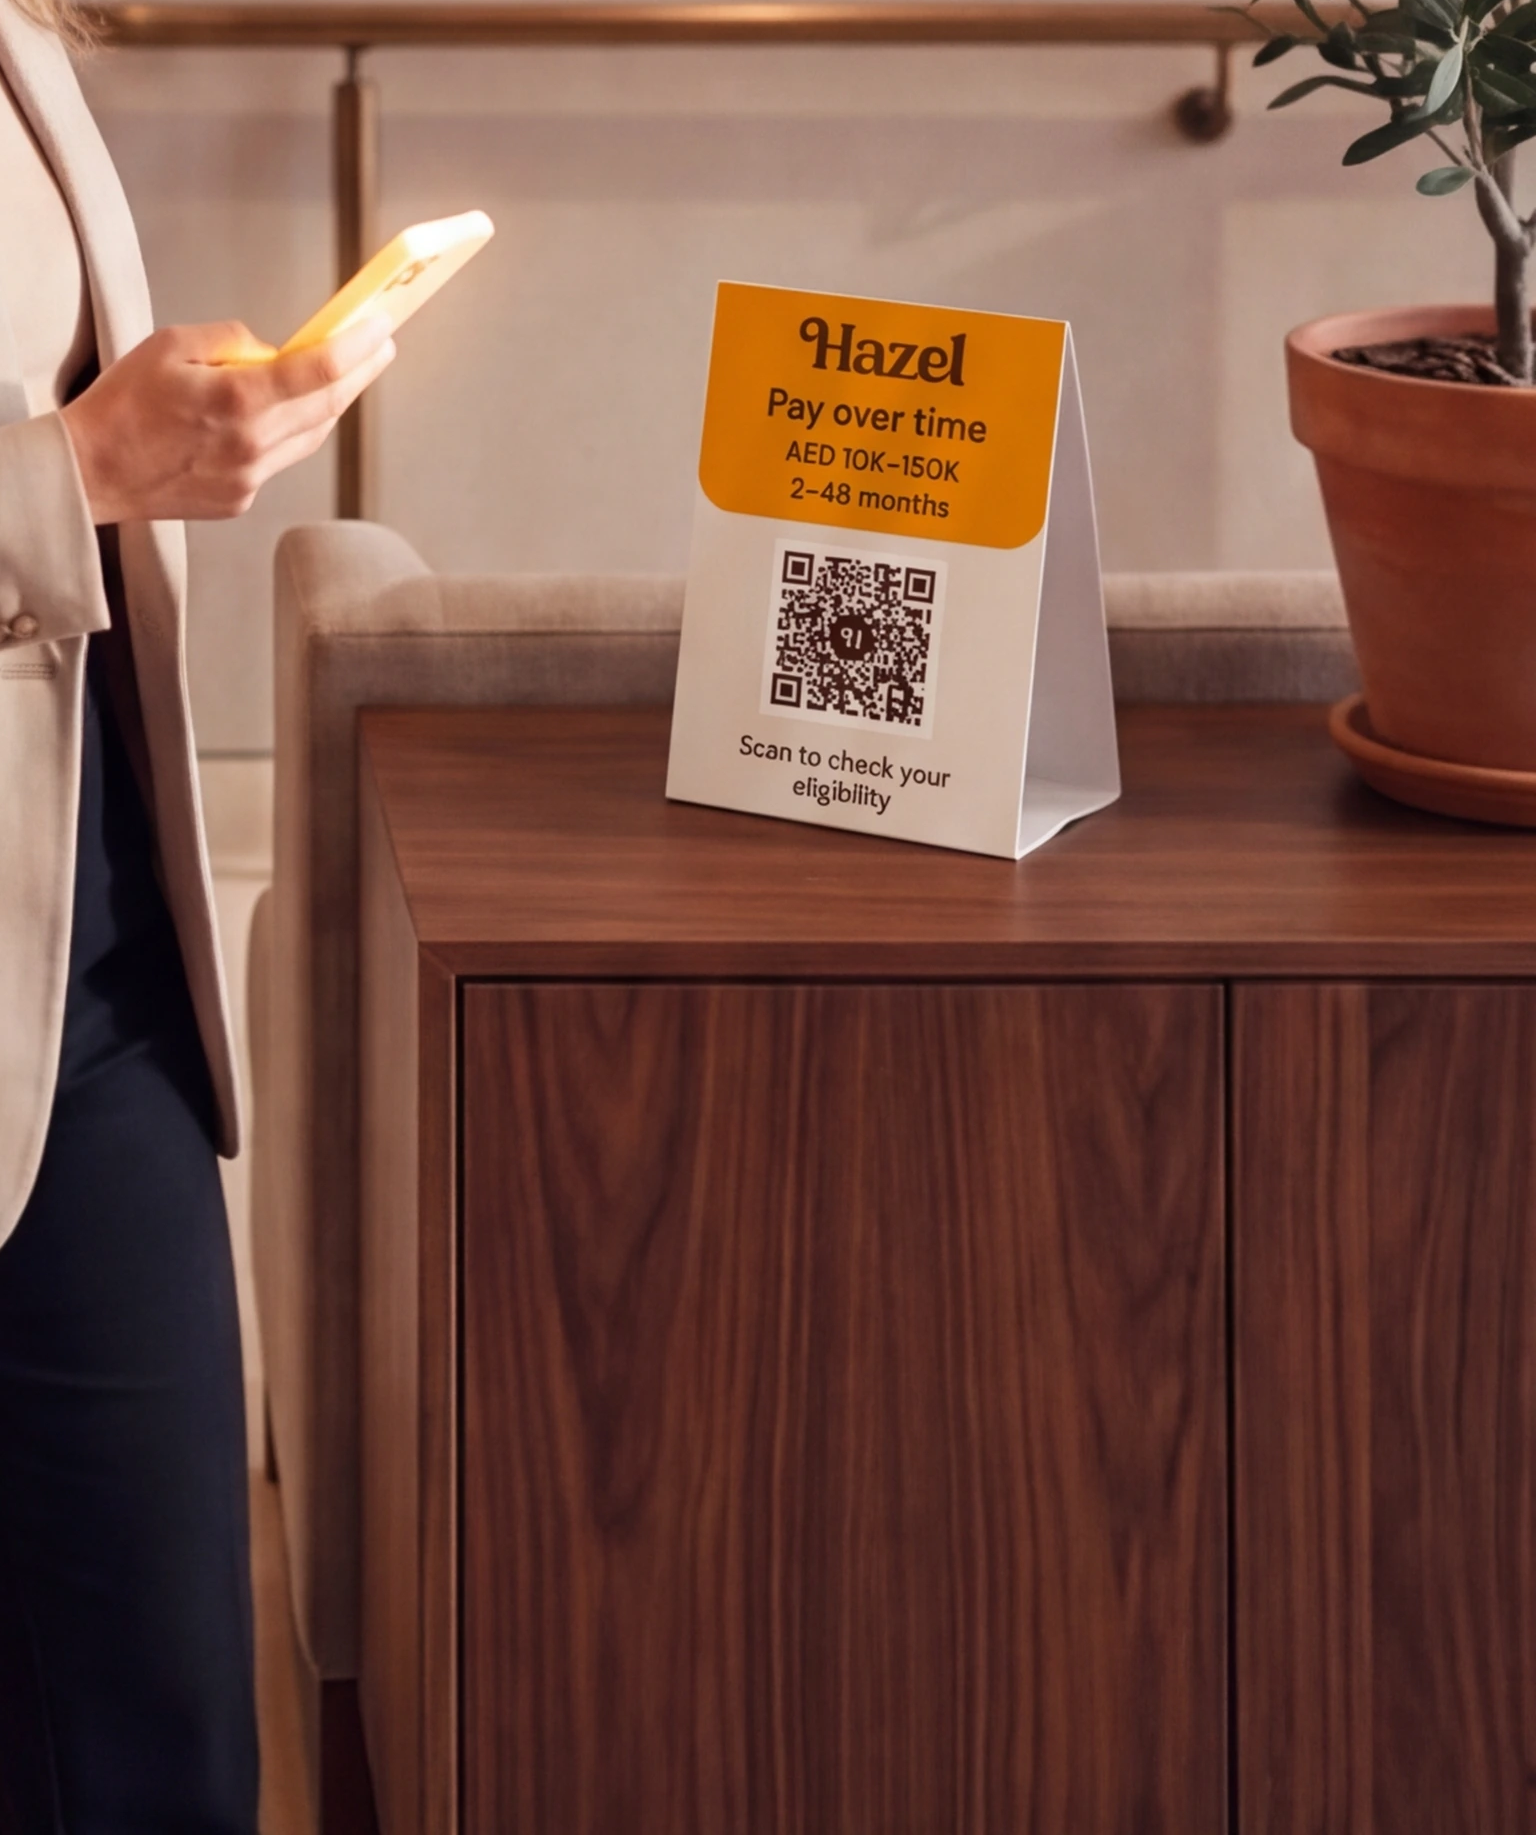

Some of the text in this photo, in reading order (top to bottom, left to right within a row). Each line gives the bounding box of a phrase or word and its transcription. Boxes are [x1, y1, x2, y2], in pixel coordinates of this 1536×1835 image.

[799, 316, 967, 387] Hazel
[767, 387, 987, 444] Pay over time
[785, 440, 836, 467] AED
[858, 490, 950, 518] months
[739, 734, 951, 788] Scan to check your
[792, 777, 891, 815] eligibility
